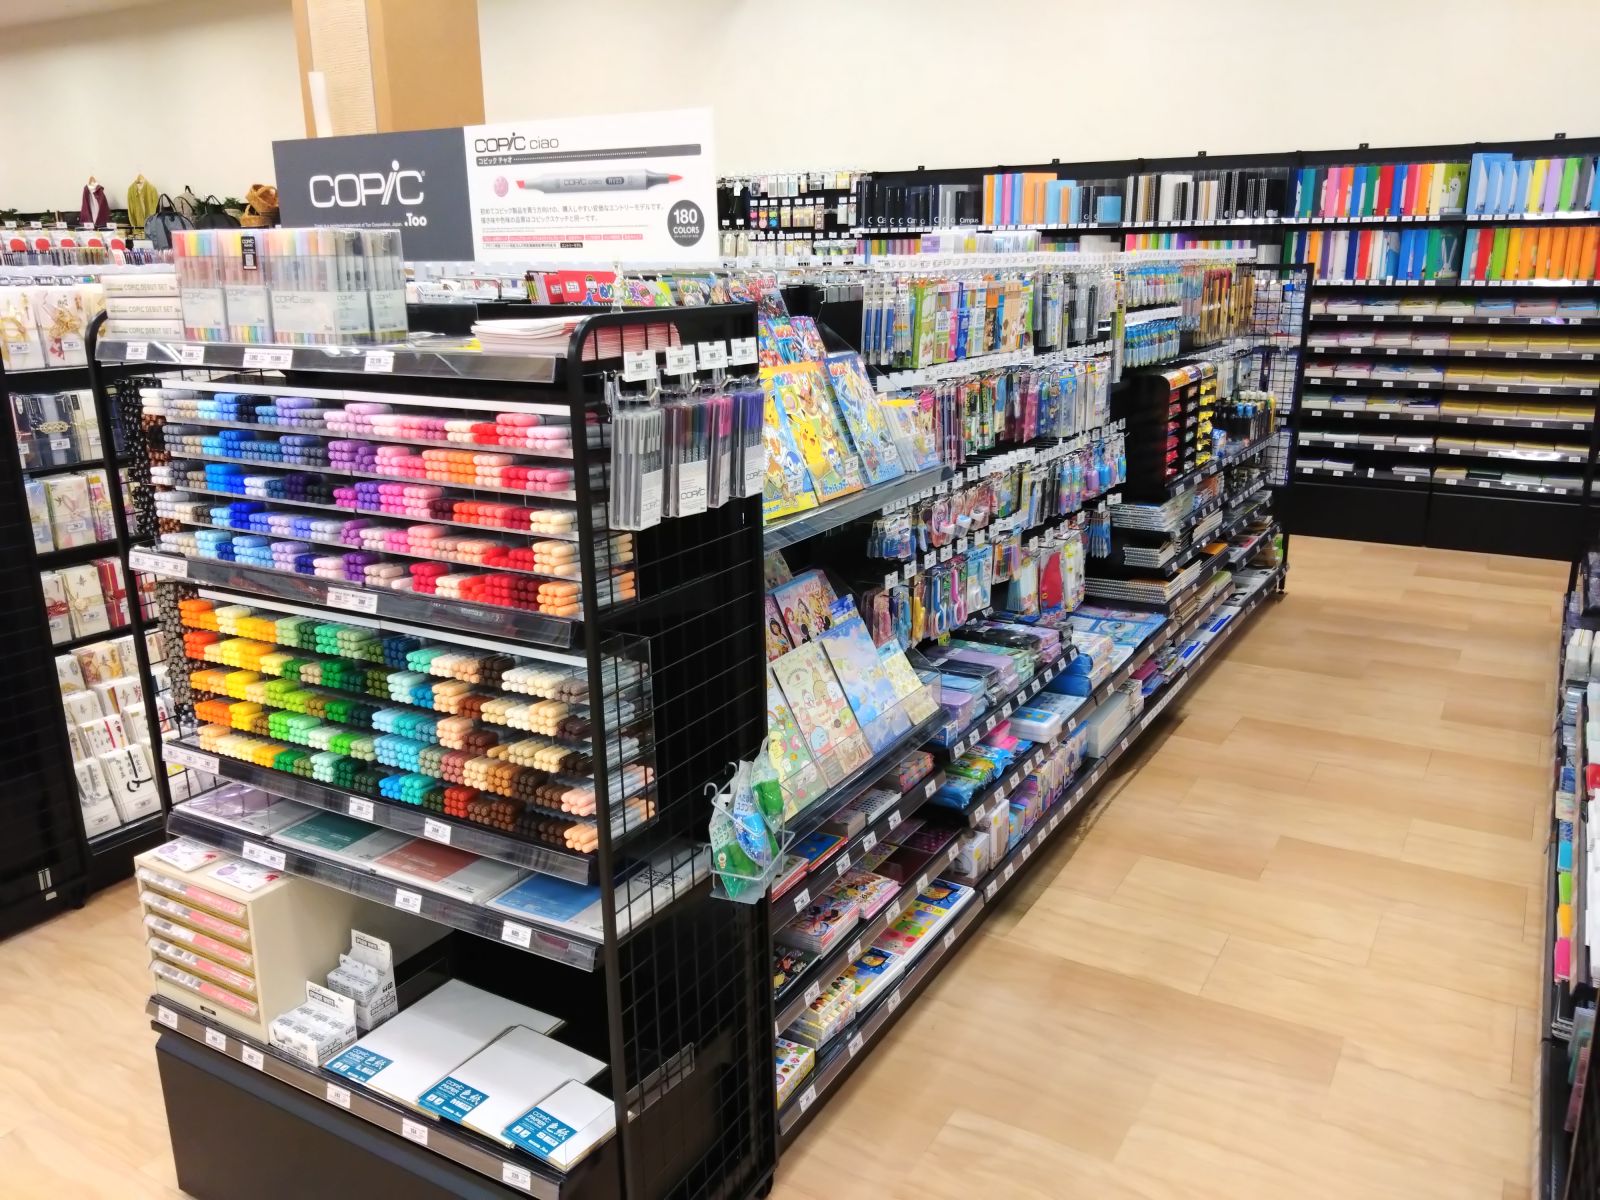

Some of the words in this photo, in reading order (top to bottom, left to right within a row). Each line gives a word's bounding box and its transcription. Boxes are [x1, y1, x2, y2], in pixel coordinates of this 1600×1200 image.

[475, 132, 526, 153] COPIC
[529, 136, 559, 150] ciao
[478, 157, 497, 165] コピック
[309, 159, 425, 208] COPIC
[404, 212, 428, 227] .Too
[673, 208, 698, 224] 180
[681, 487, 706, 500] COPIC
[460, 1089, 482, 1106] 色紙
[546, 1122, 570, 1140] 色紙
